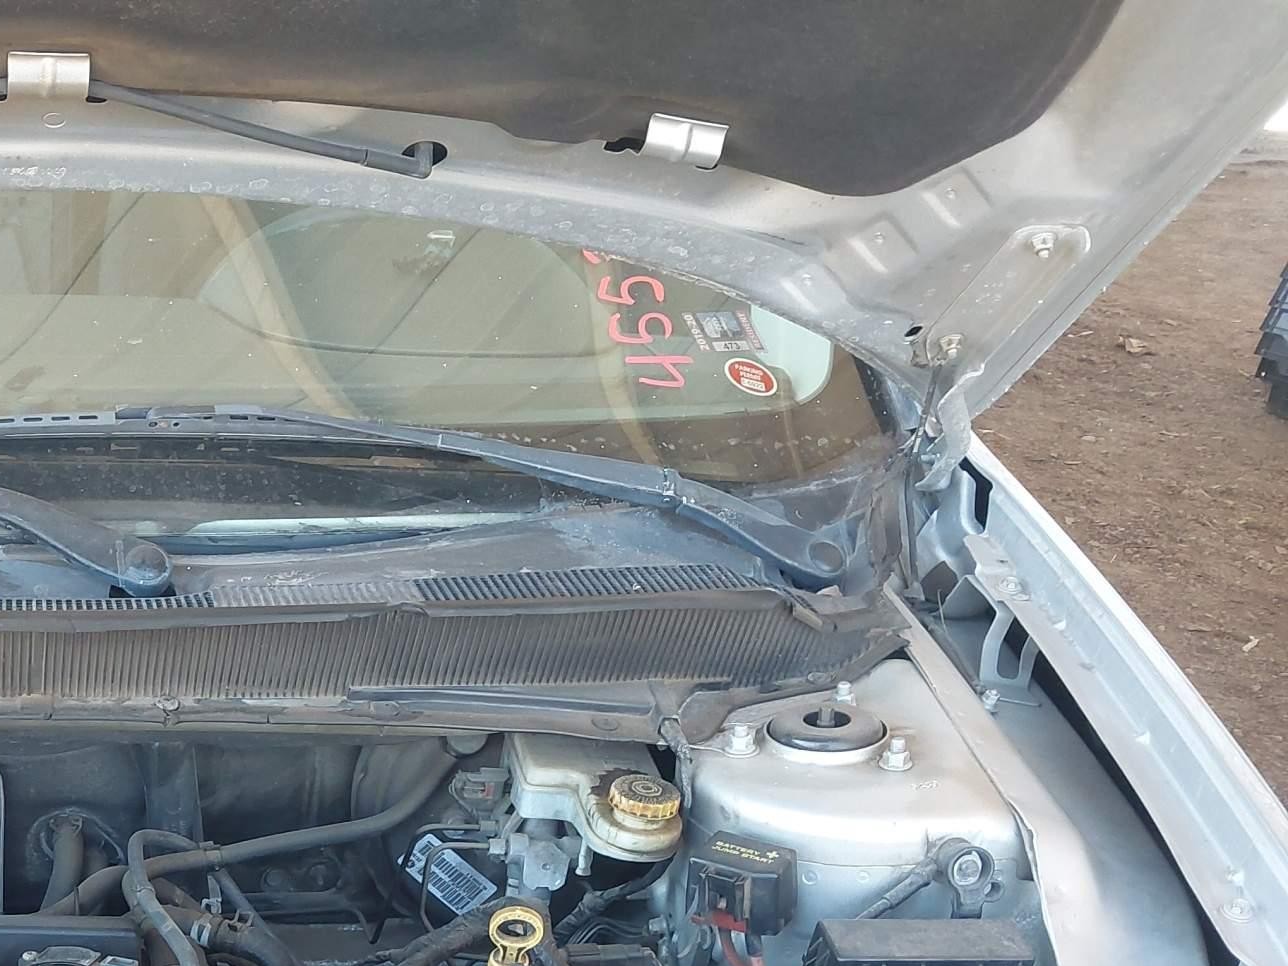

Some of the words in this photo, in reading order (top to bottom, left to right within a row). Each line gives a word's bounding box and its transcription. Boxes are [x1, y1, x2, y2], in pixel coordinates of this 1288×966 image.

[582, 248, 693, 388] 455
[711, 845, 740, 855] JUMP
[740, 853, 775, 864] START
[715, 841, 760, 855] BATTERY
